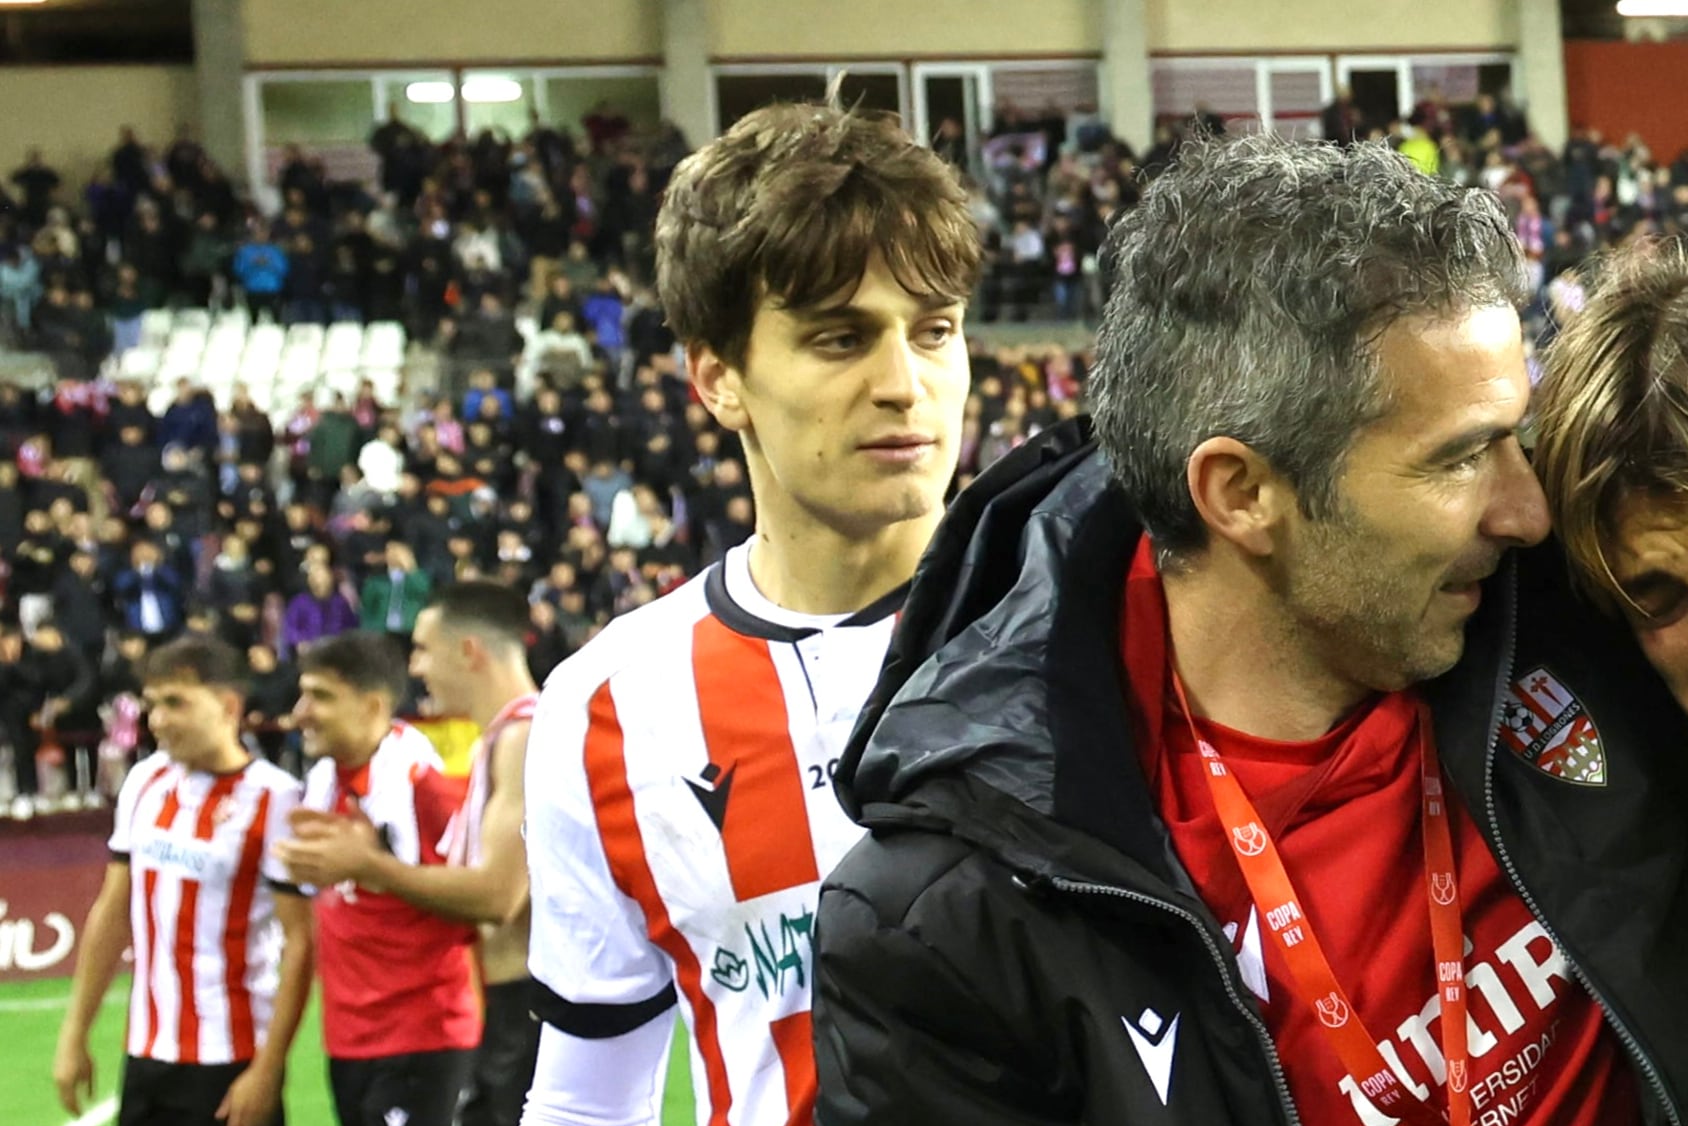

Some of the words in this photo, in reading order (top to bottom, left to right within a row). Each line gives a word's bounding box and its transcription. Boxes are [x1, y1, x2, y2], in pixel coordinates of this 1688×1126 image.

[1266, 901, 1302, 931] COPA
[1282, 925, 1304, 947] REY
[1439, 961, 1463, 982] COPA
[1360, 1069, 1396, 1098] COPA
